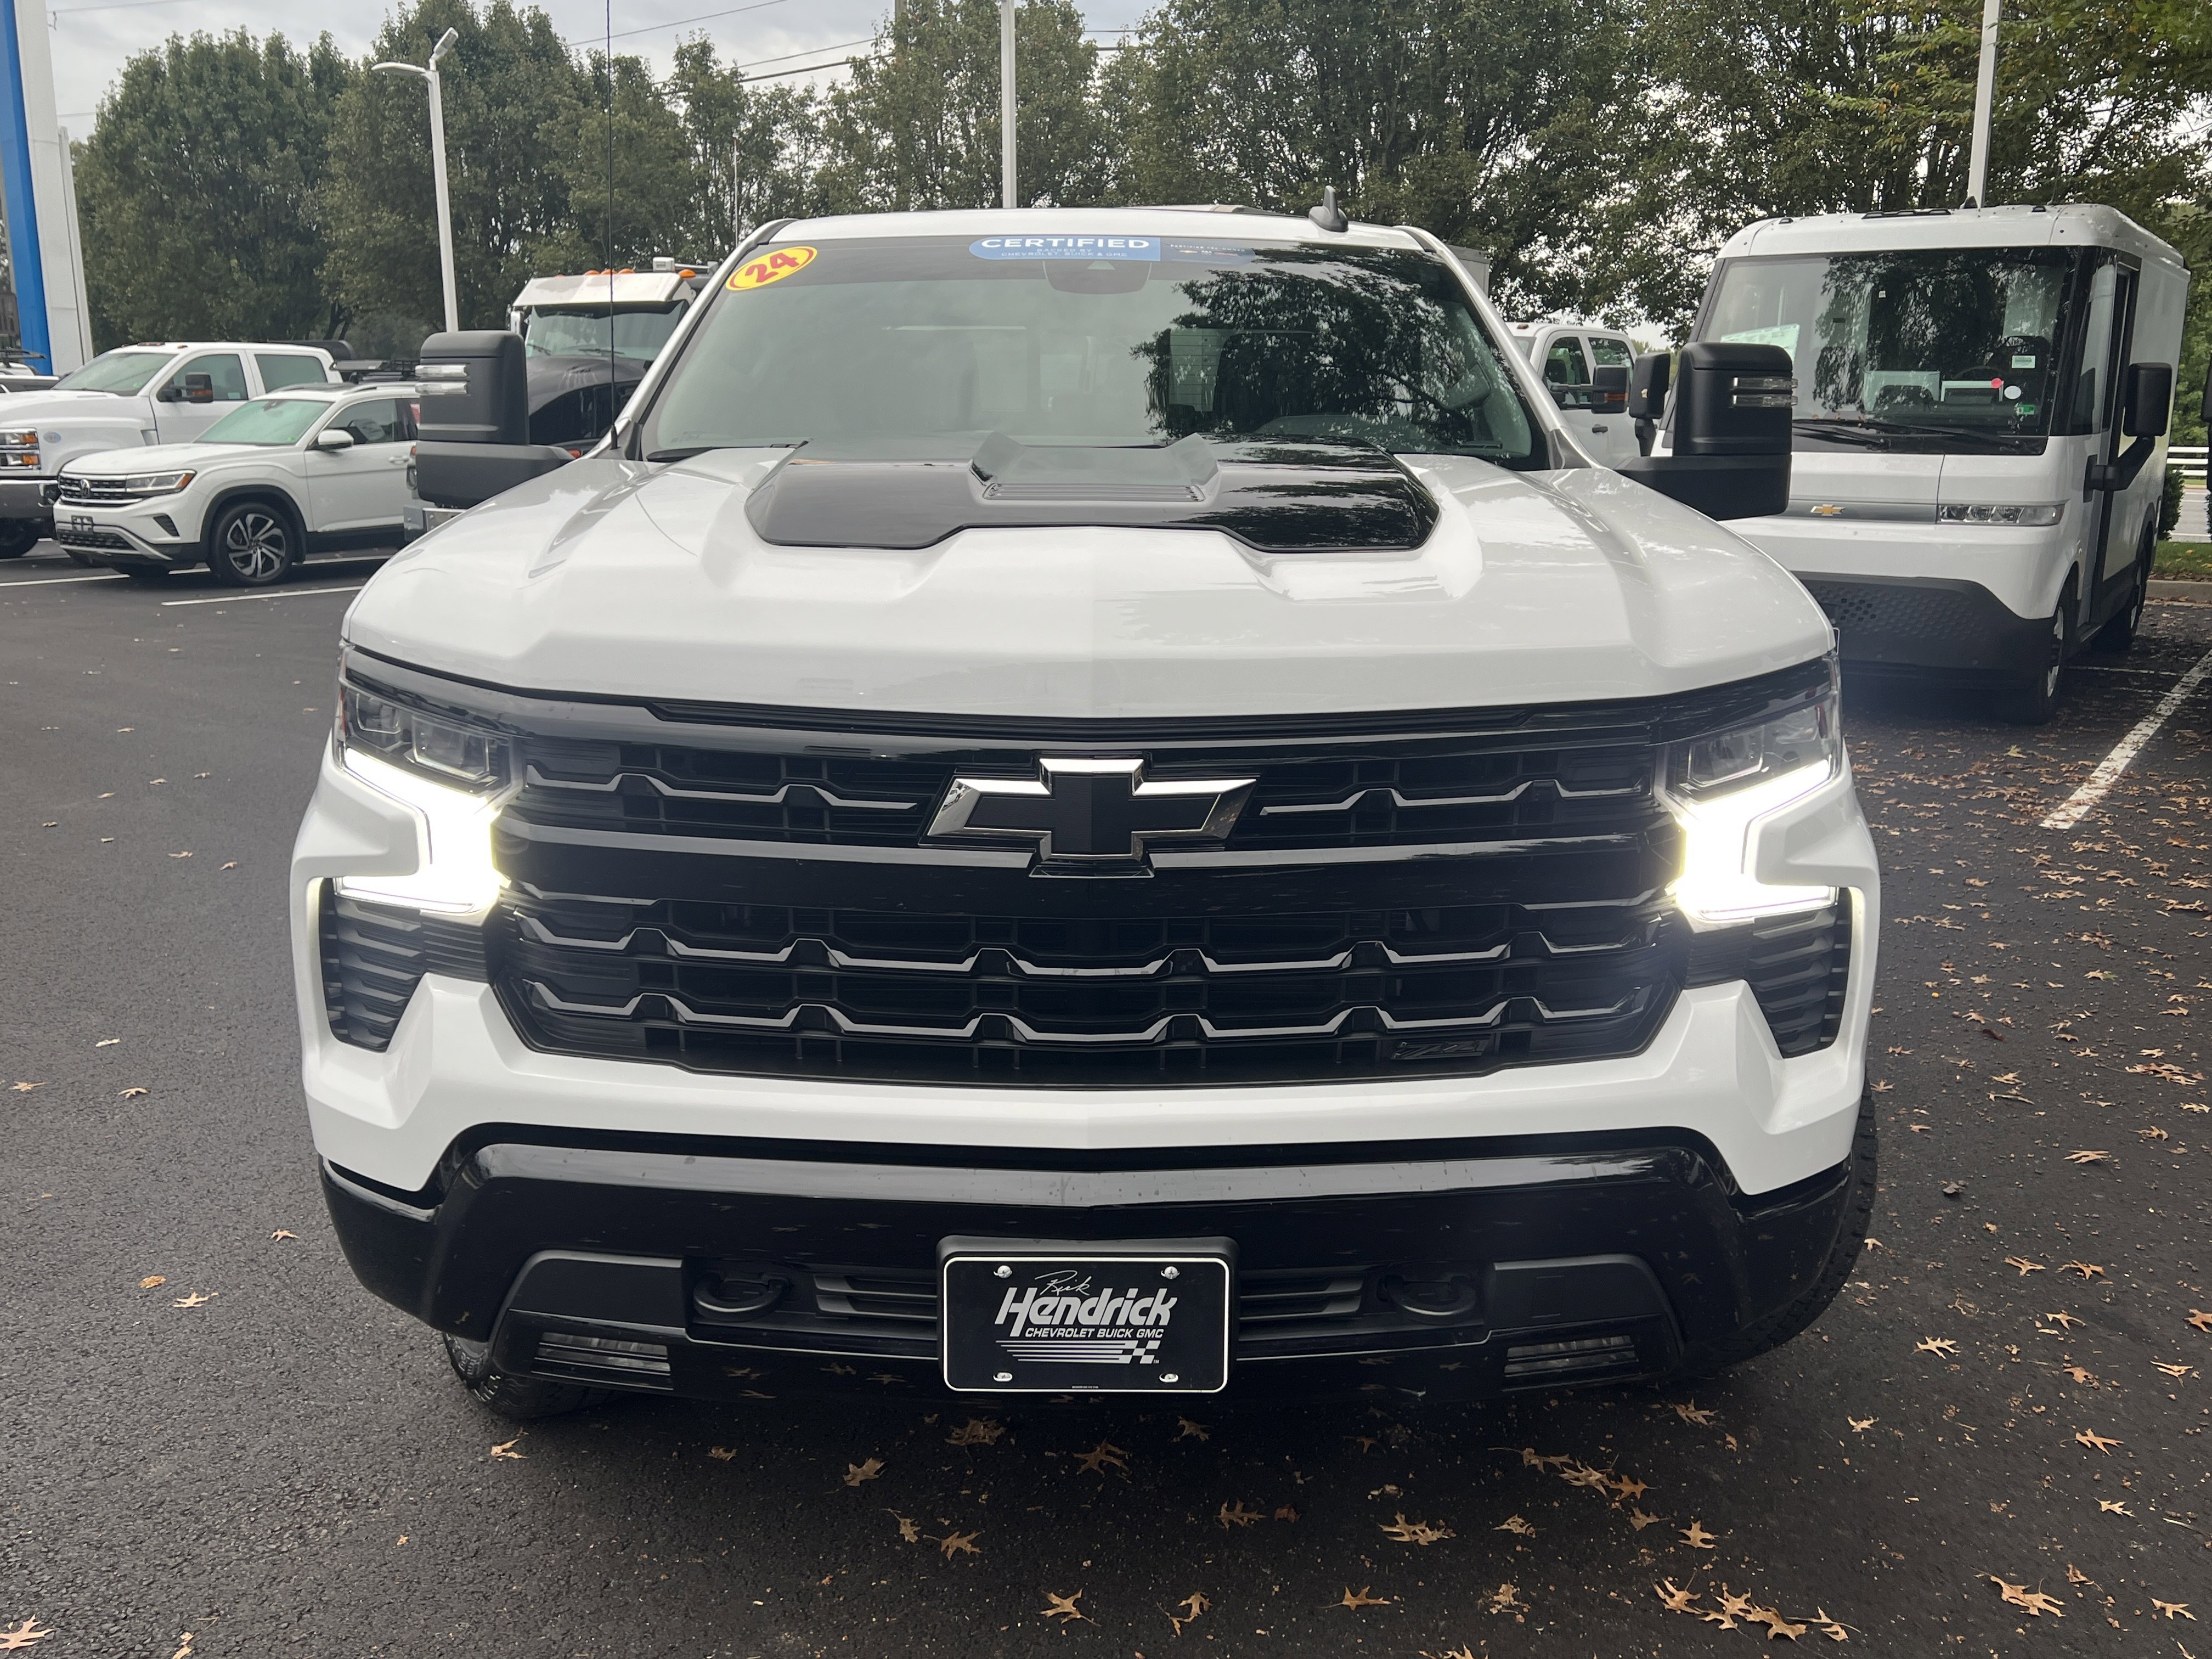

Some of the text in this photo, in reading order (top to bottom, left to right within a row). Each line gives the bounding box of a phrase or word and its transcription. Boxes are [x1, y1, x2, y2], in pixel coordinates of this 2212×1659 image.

[981, 238, 1150, 249] CERTIFIED
[744, 252, 800, 283] 24
[994, 1287, 1178, 1338] Hendrick
[1025, 1328, 1164, 1339] CHEVROLET BUICK GMC
